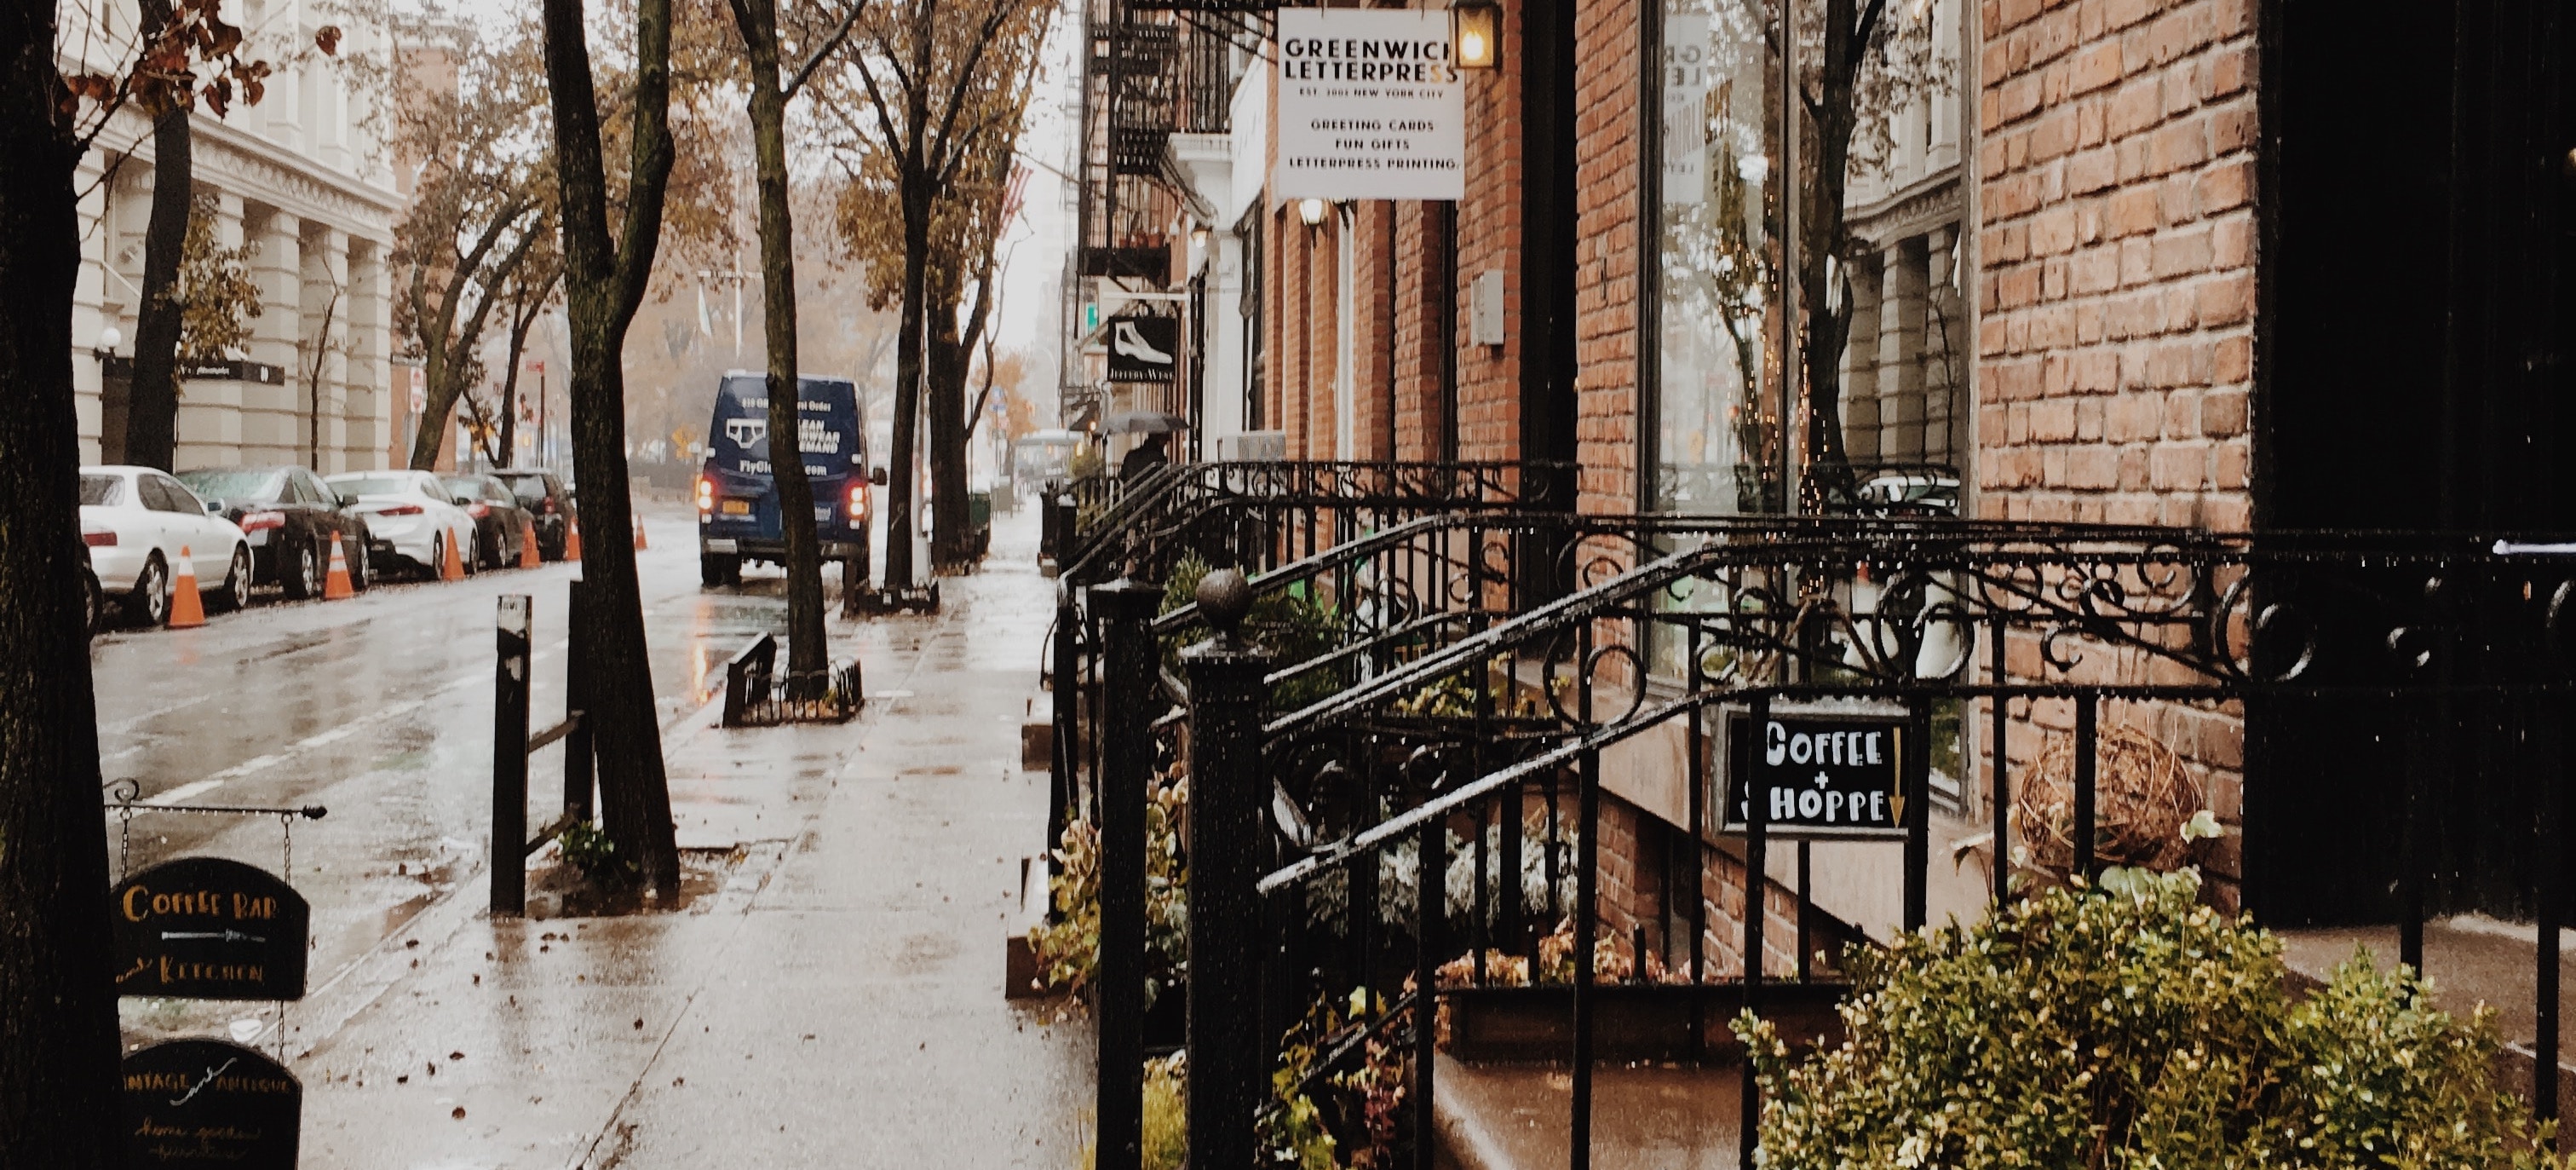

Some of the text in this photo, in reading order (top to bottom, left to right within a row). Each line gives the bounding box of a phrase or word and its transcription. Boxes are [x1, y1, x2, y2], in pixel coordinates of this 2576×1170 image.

[1285, 61, 1458, 84] LETTERPRESS
[1354, 88, 1378, 98] NEW
[1385, 88, 1414, 99] YORK
[1419, 89, 1443, 100] CITY
[1311, 118, 1434, 132] GREETING CARDS
[1336, 138, 1409, 151] FUN GIFTS
[1290, 156, 1380, 170] LETTERPRESS
[797, 418, 825, 432] LEAN
[799, 441, 838, 454] EMAND
[1766, 721, 1883, 766] COFFEE
[123, 885, 277, 922] COFFEE BAR
[159, 954, 263, 986] KITCHEN
[123, 1071, 190, 1094] INTAGE
